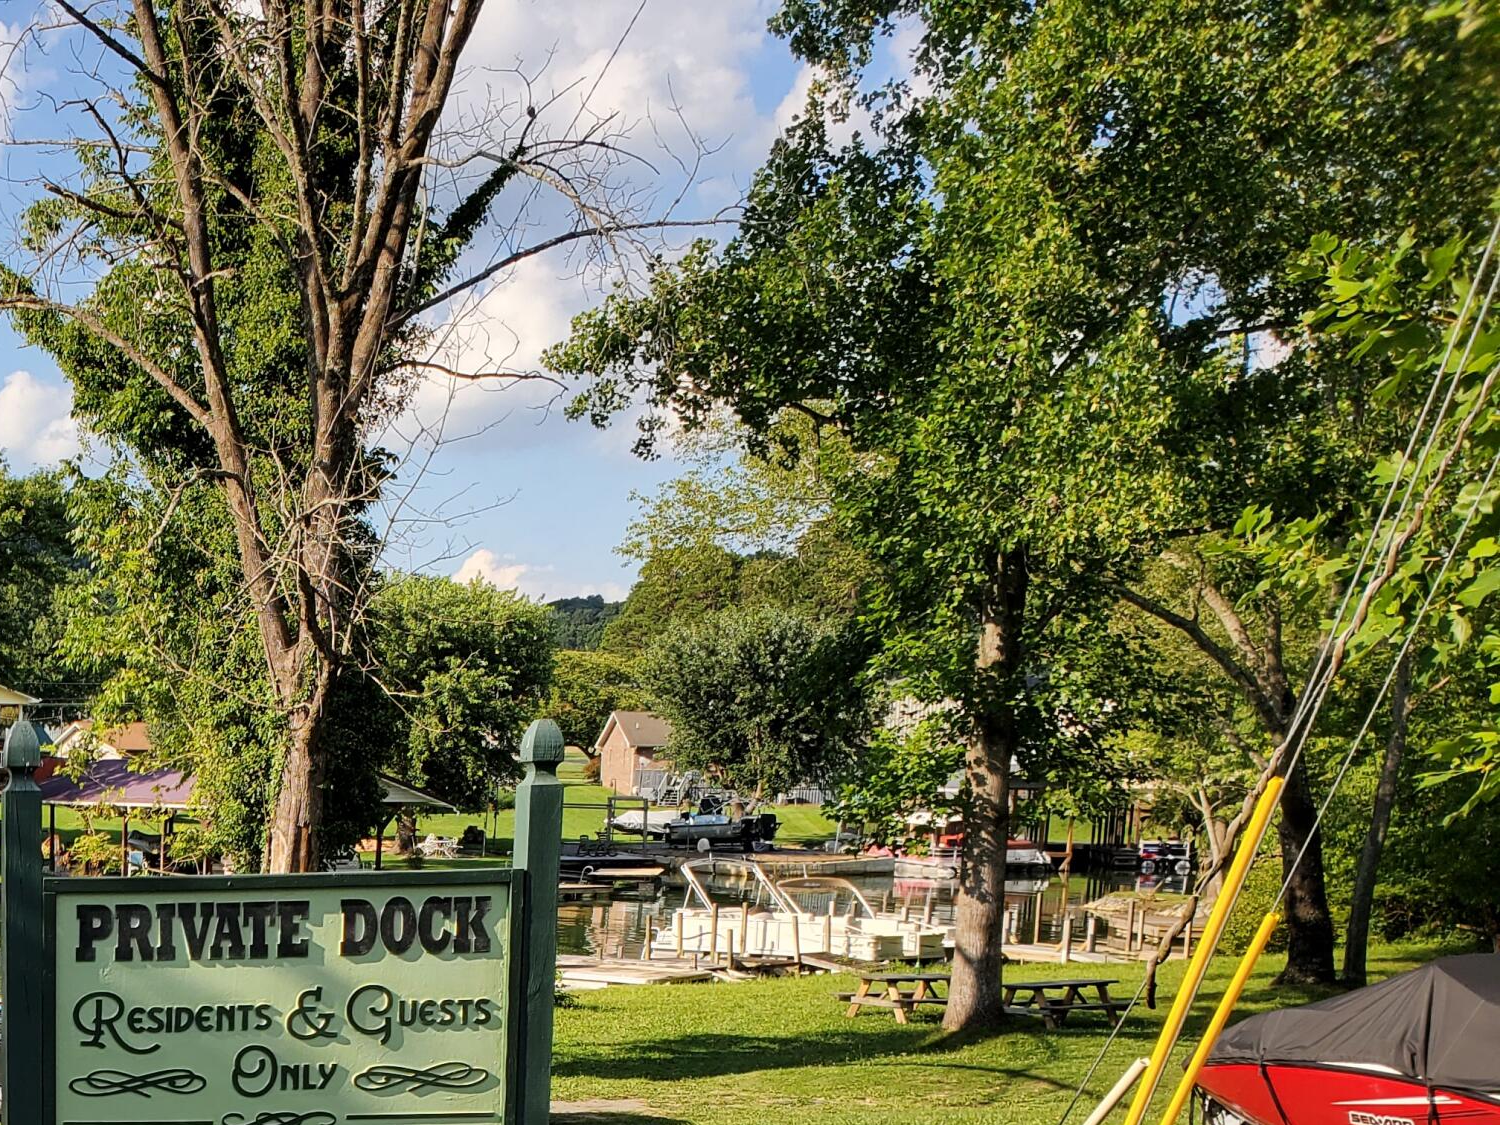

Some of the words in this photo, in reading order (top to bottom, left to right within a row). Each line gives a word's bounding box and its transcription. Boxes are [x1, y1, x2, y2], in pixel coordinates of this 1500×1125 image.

[76, 900, 310, 962] PRIVATE
[340, 896, 492, 956] DOCK
[286, 985, 338, 1041] &
